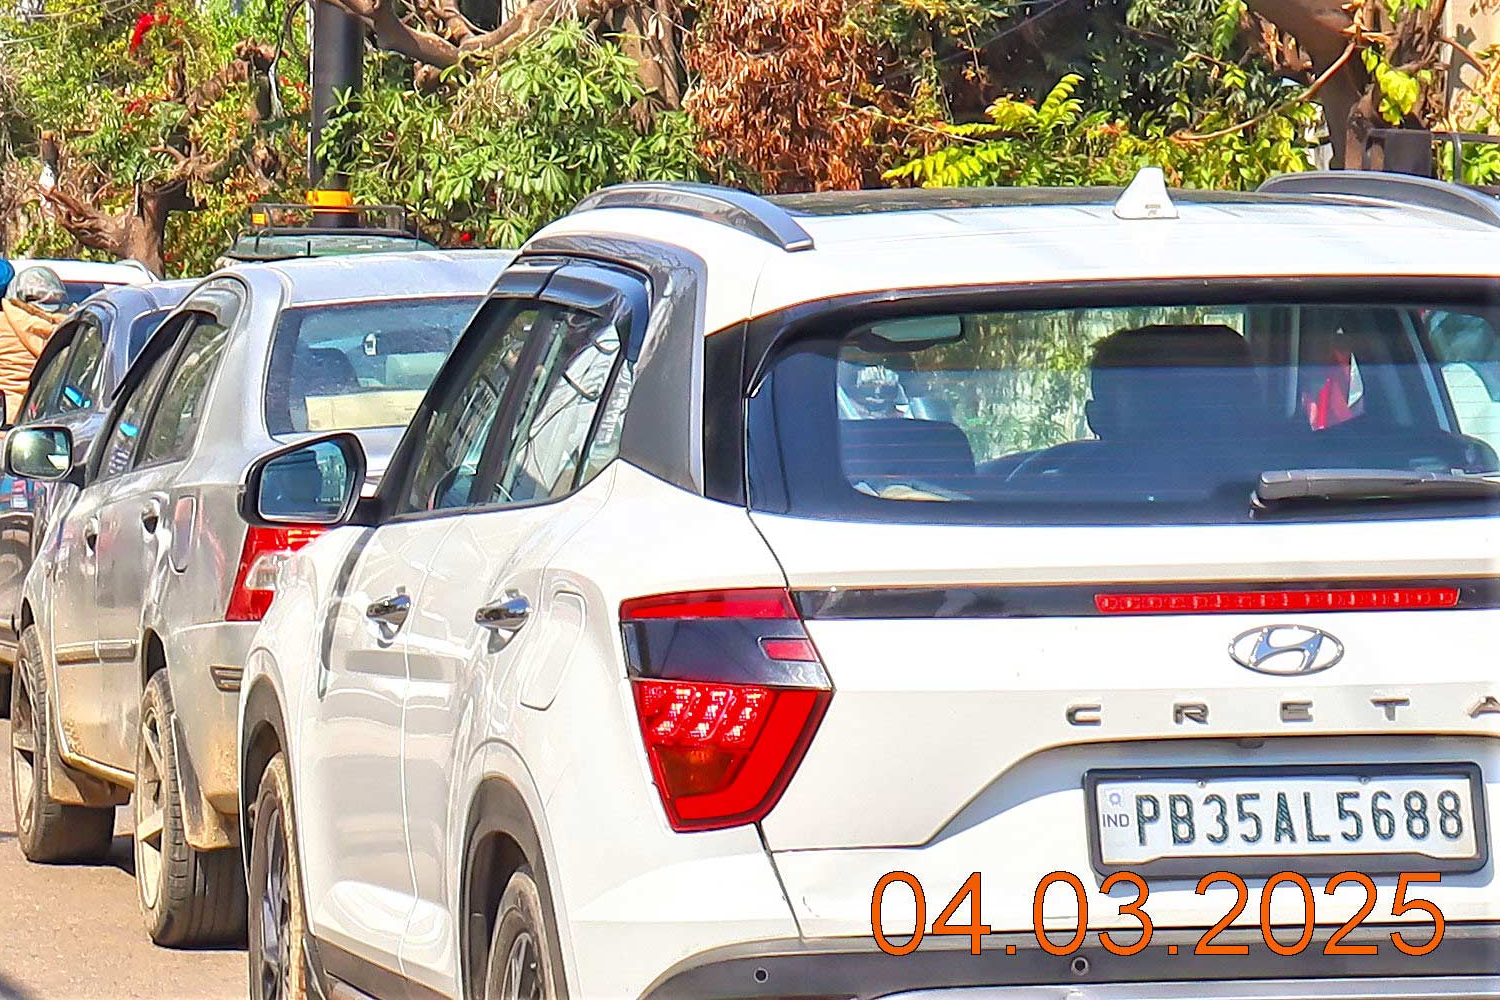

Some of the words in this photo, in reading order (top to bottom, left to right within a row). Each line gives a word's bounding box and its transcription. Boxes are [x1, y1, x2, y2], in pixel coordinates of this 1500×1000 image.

[1065, 696, 1500, 726] CRETA
[1102, 813, 1130, 828] IND
[1136, 789, 1464, 846] PB35AL5688
